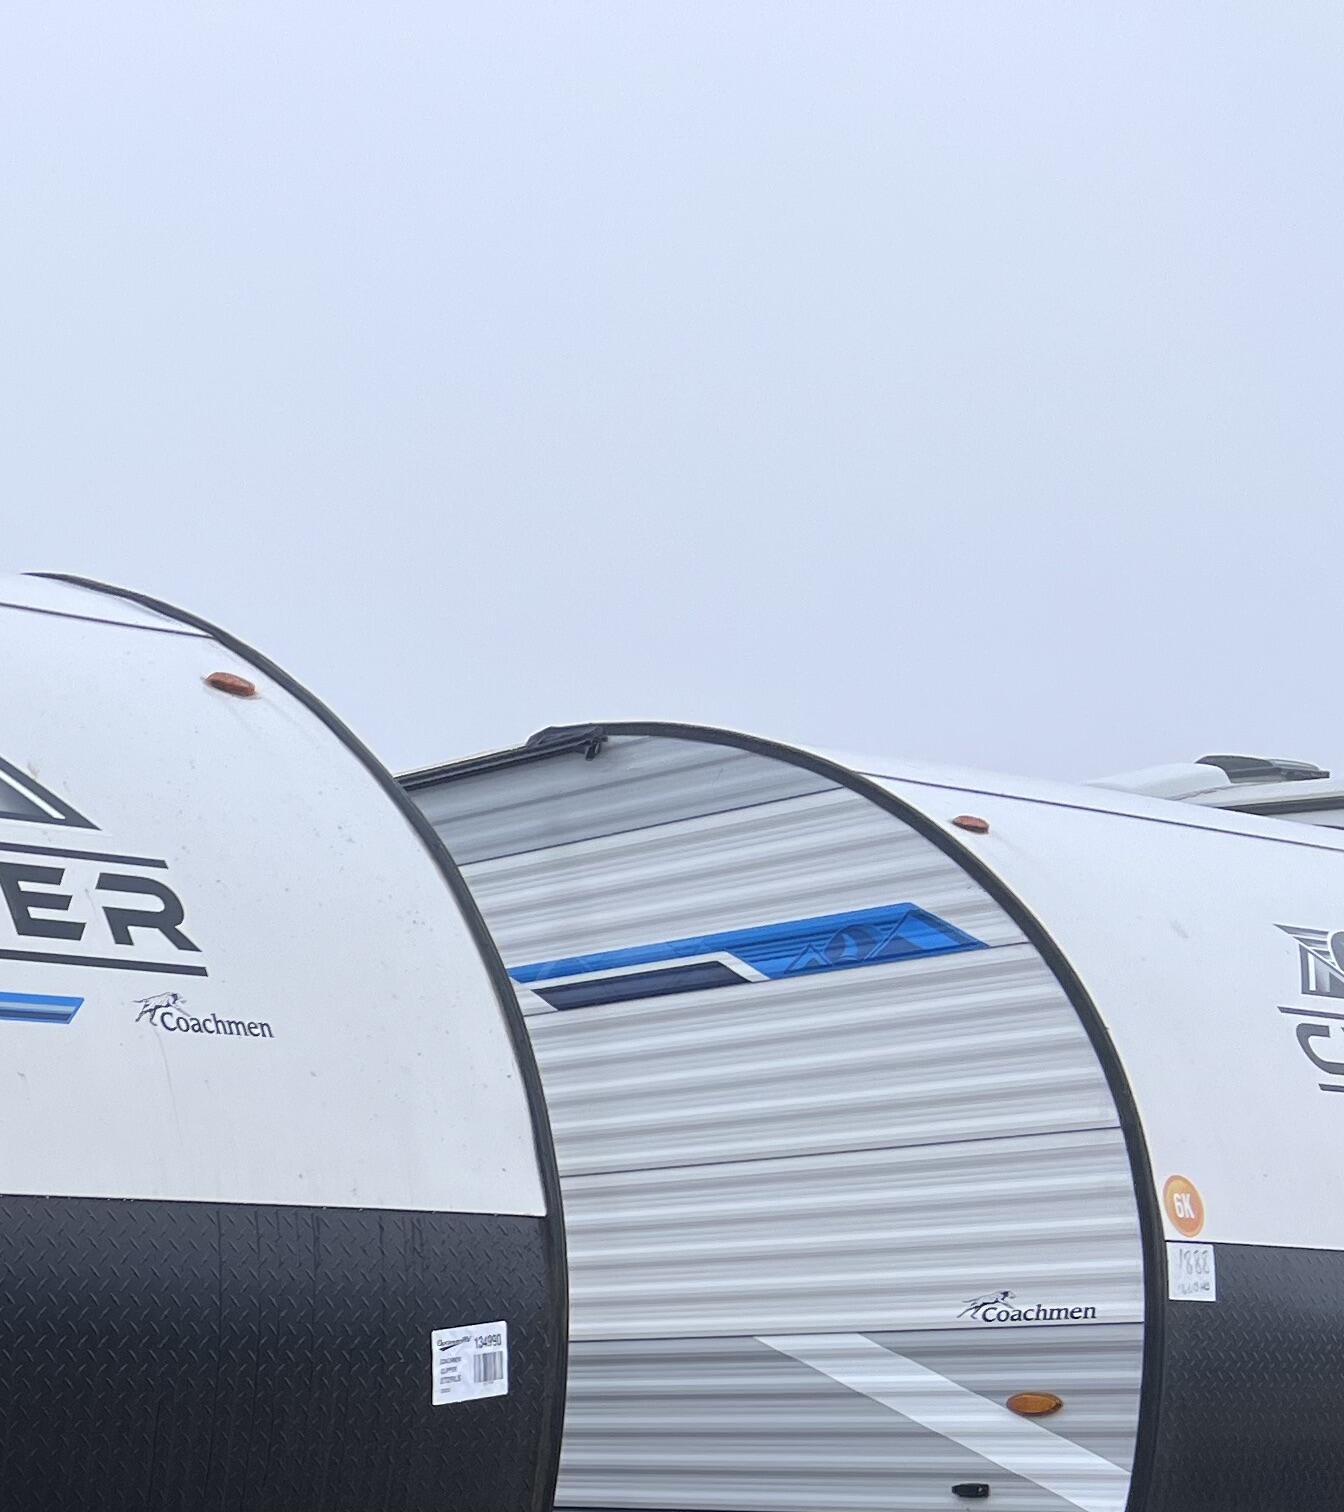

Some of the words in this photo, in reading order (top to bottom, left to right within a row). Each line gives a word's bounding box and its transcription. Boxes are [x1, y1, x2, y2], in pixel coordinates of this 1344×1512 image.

[160, 1009, 274, 1039] Coachmen
[1173, 1192, 1195, 1219] 6K
[982, 1304, 1096, 1323] Coachmen
